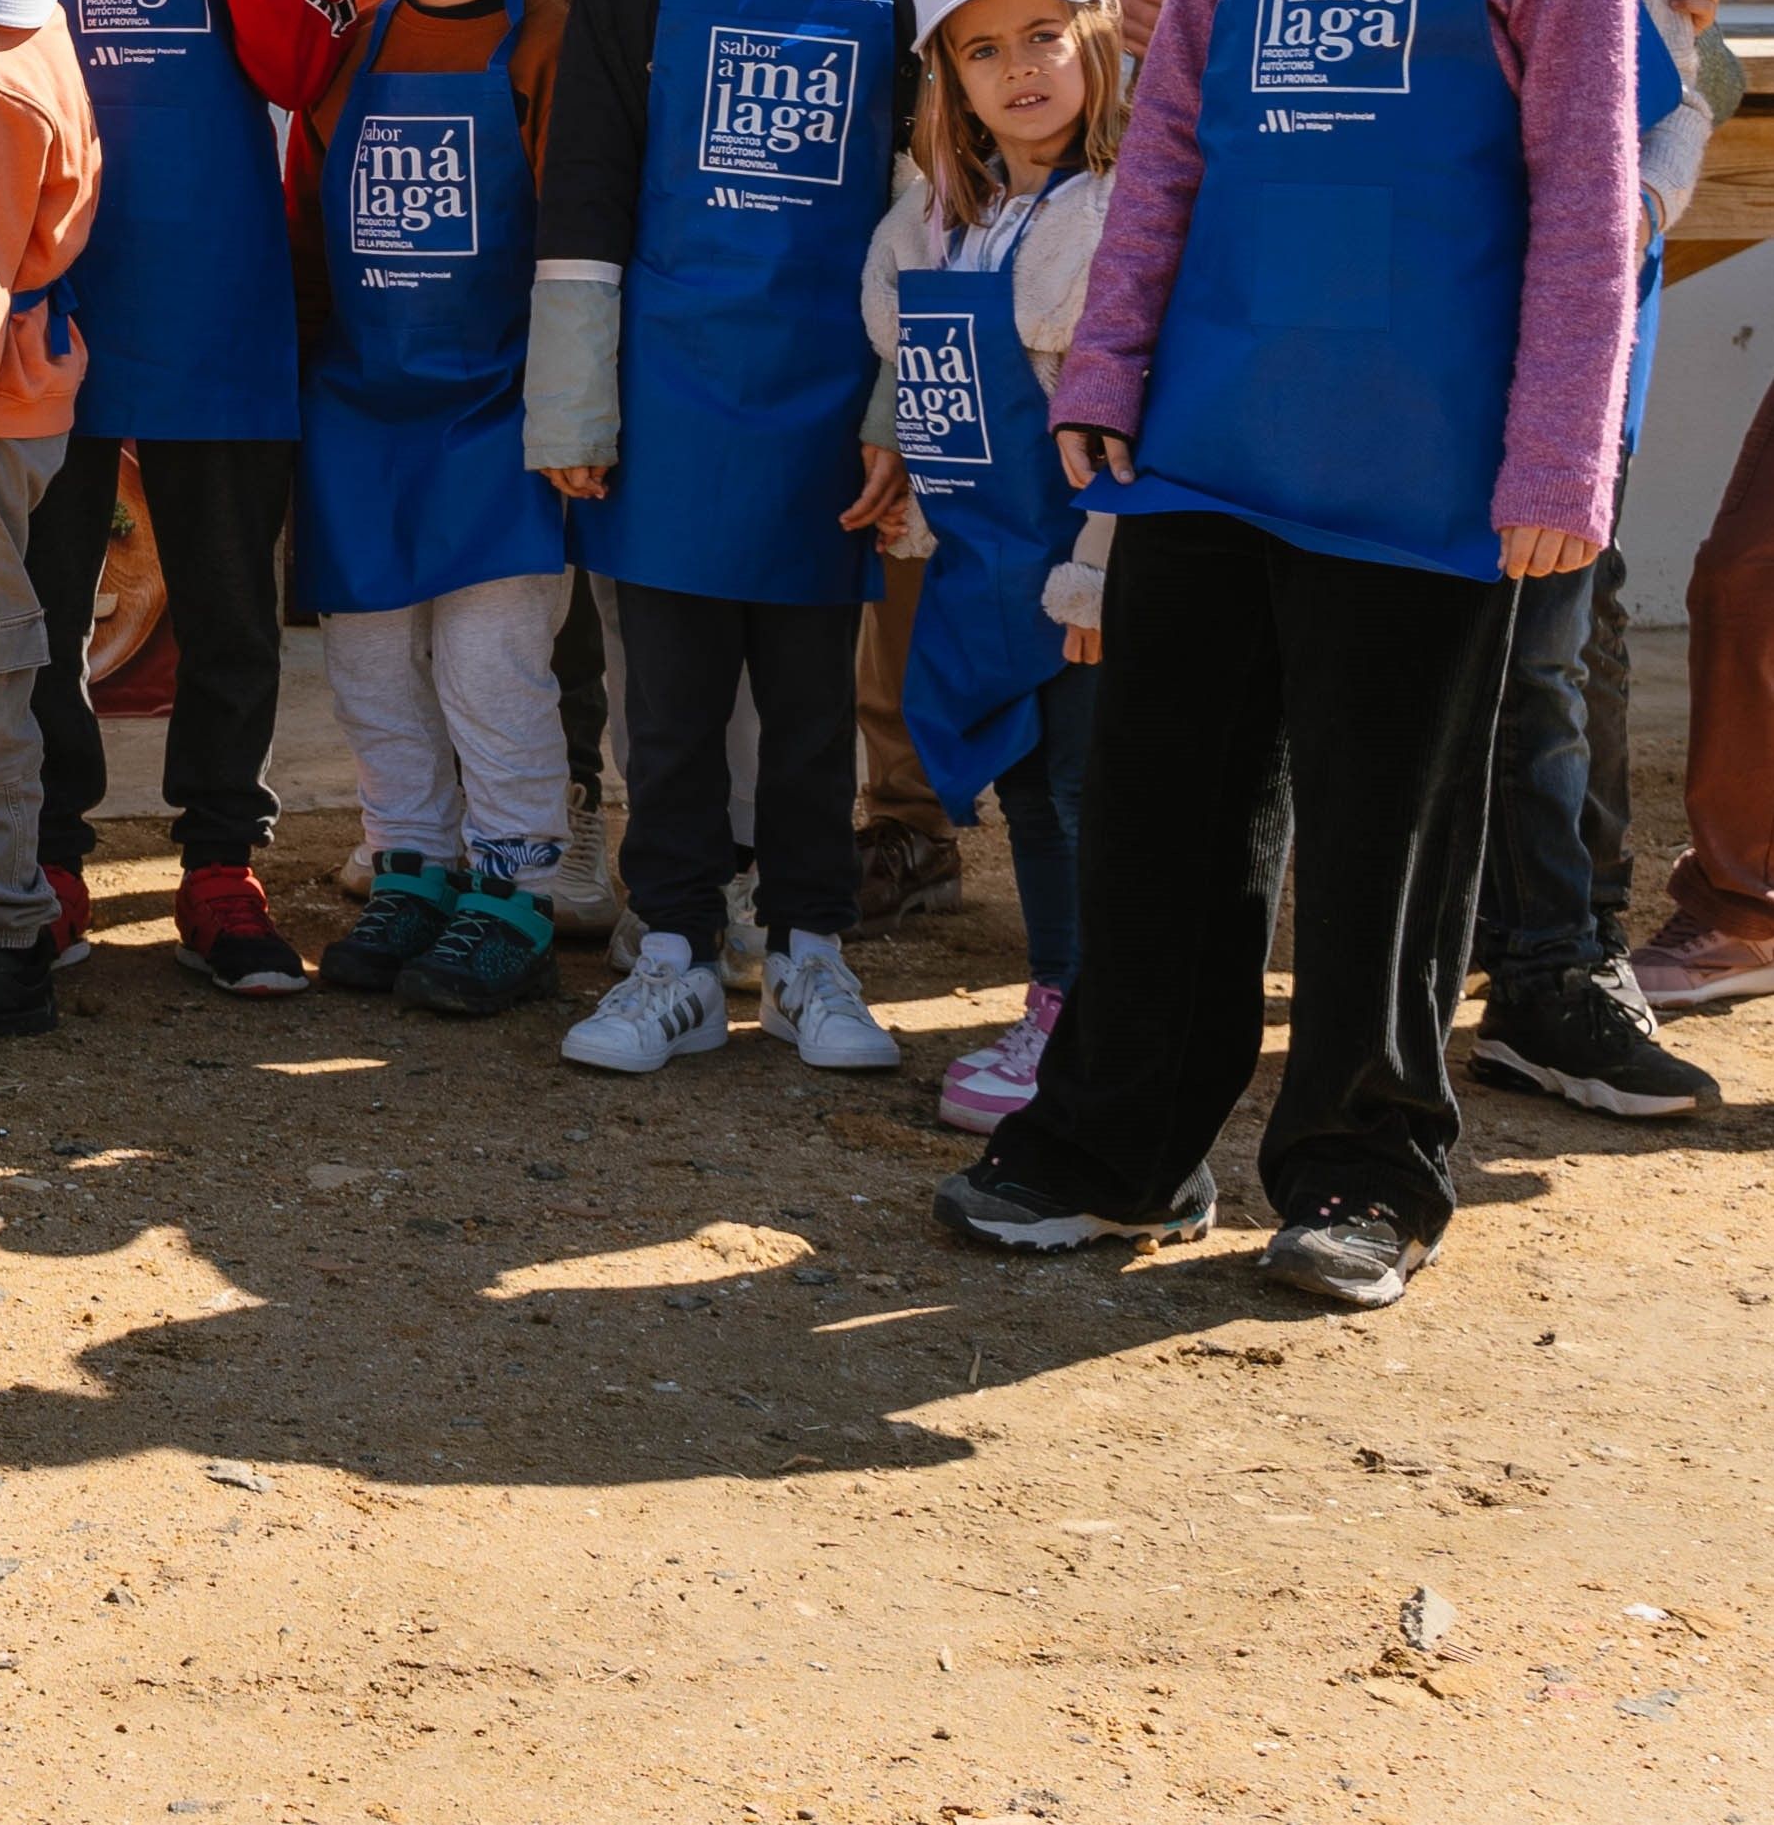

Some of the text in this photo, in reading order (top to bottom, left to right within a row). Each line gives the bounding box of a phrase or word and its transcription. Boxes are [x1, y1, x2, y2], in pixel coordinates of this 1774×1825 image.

[719, 36, 782, 59] sabor
[718, 52, 843, 107] a má
[363, 121, 402, 142] sabor
[712, 83, 837, 153] laga
[370, 129, 466, 182] má
[357, 168, 467, 231] laga
